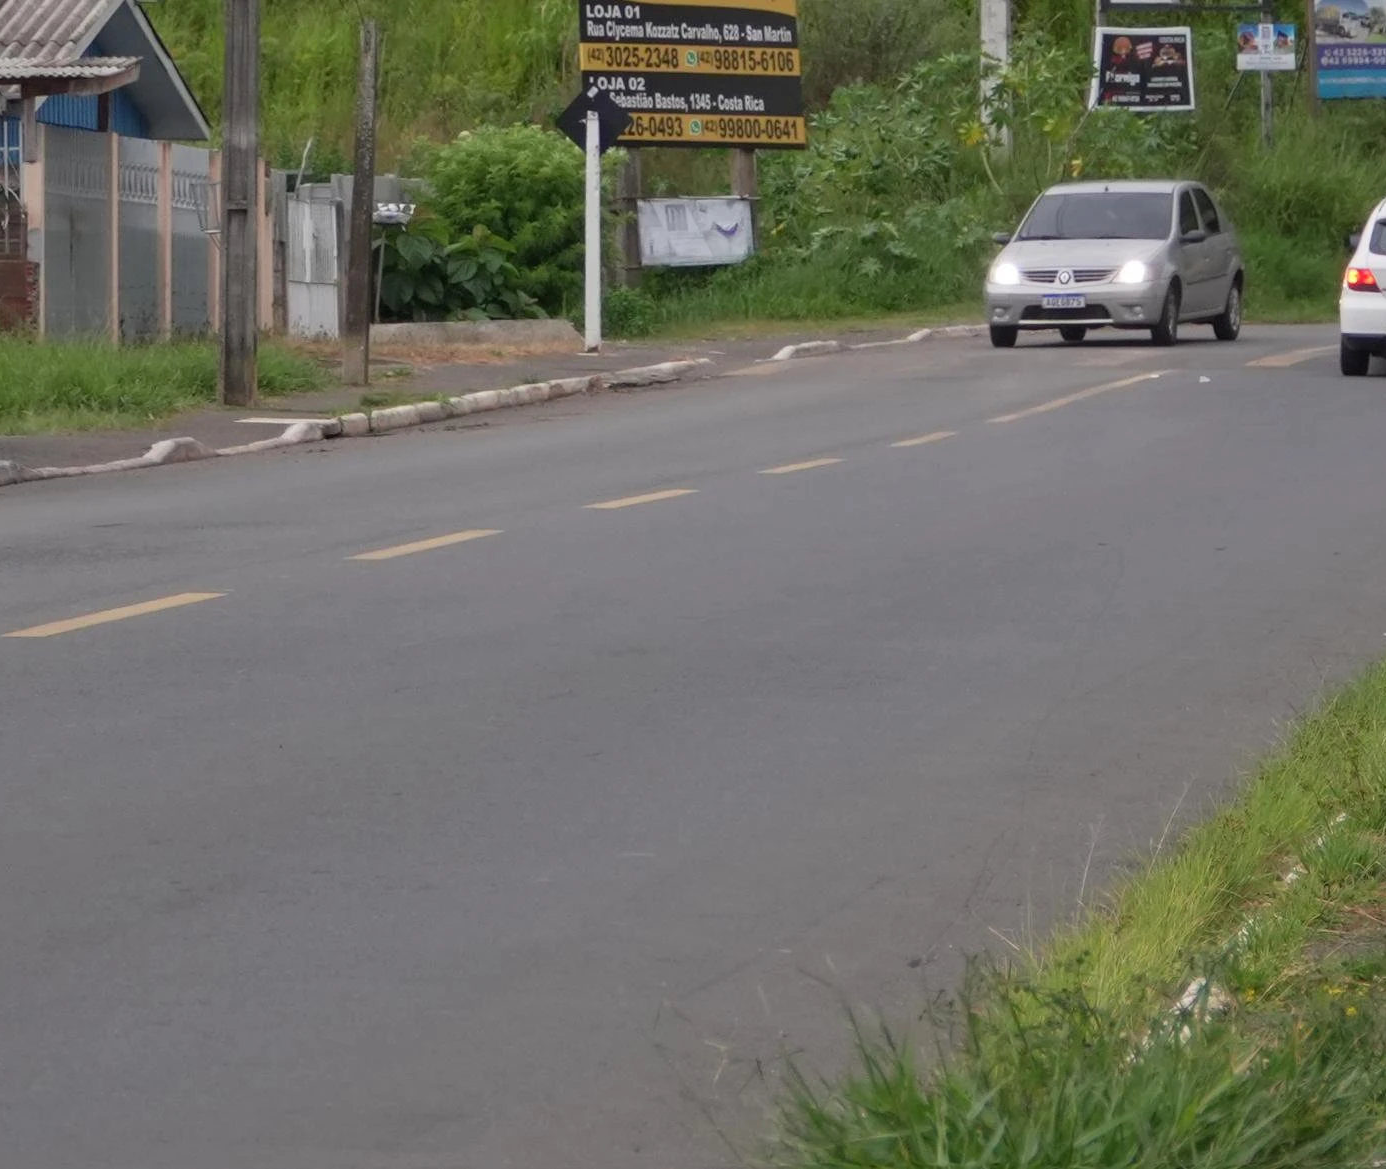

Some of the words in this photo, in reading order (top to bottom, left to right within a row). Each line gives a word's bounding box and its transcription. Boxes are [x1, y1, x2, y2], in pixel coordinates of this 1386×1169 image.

[585, 4, 622, 19] LOJA
[624, 5, 640, 19] 01
[587, 20, 604, 37] Rua
[681, 23, 722, 44] Carvalho,
[723, 24, 740, 40] 628
[746, 25, 763, 42] San
[763, 25, 792, 42] Martin
[606, 46, 679, 69] 3025-2348
[714, 49, 794, 72] 98815-6106
[628, 77, 646, 91] 02
[655, 93, 688, 112] Bastos,
[690, 93, 711, 110] 1345
[717, 94, 743, 111] Costa
[744, 95, 765, 111] Rica
[718, 118, 798, 140] 99800-0641
